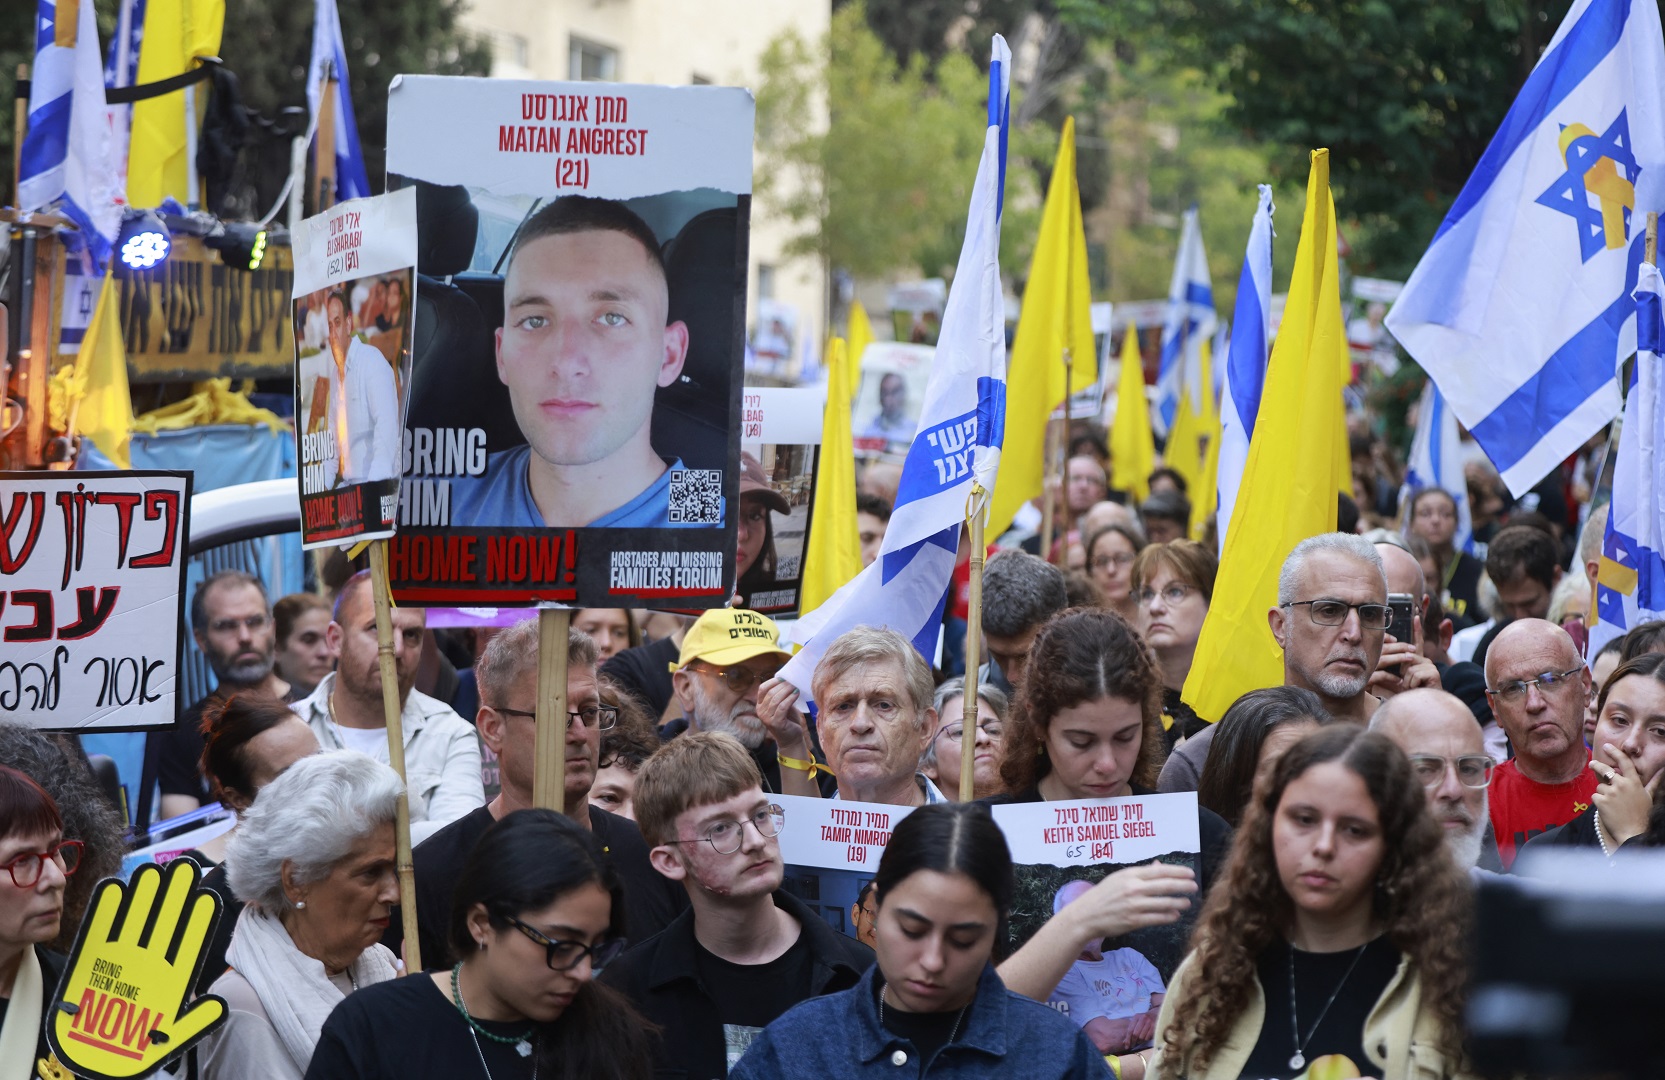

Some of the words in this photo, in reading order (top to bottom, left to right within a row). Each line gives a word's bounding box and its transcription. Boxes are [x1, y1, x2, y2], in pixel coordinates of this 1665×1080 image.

[521, 93, 589, 122] אנגרסט
[595, 96, 628, 125] מתן
[499, 125, 561, 153] MATAN
[566, 127, 648, 156] ANGREST
[555, 157, 589, 189] (21)
[345, 211, 361, 229] אלי
[334, 231, 362, 254] SHARABI
[327, 256, 344, 279] (52)
[302, 429, 335, 464] BRING
[402, 427, 487, 476] BRING
[303, 463, 325, 495] HIM
[304, 496, 336, 529] HOME
[337, 485, 363, 523] NOW!
[400, 479, 450, 527] HIM
[389, 535, 477, 583] HOME
[486, 529, 576, 583] NOW!
[611, 551, 660, 568] HOSTAGES
[661, 551, 680, 568] AND
[682, 552, 723, 568] MISSING
[610, 567, 671, 589] FAMILIES
[674, 567, 723, 589] FORUM
[0, 585, 121, 643] עכ
[733, 612, 762, 625] כולנו
[729, 627, 773, 641] חטופים
[84, 655, 165, 707] אסור
[831, 808, 862, 827] נמרודי
[865, 812, 889, 829] תמיר
[1054, 807, 1079, 825] סיגל
[1082, 805, 1118, 823] שמואל
[820, 825, 851, 843] TAMIR
[1043, 826, 1074, 844] KEITH
[1077, 823, 1120, 842] SAMUEL
[1123, 821, 1156, 839] SIEGEL
[847, 844, 867, 864] (19)
[1066, 845, 1086, 858] 65
[92, 957, 123, 979] BRING
[88, 972, 114, 992] THEM
[114, 980, 141, 1001] HOME
[71, 987, 164, 1052] NOW
